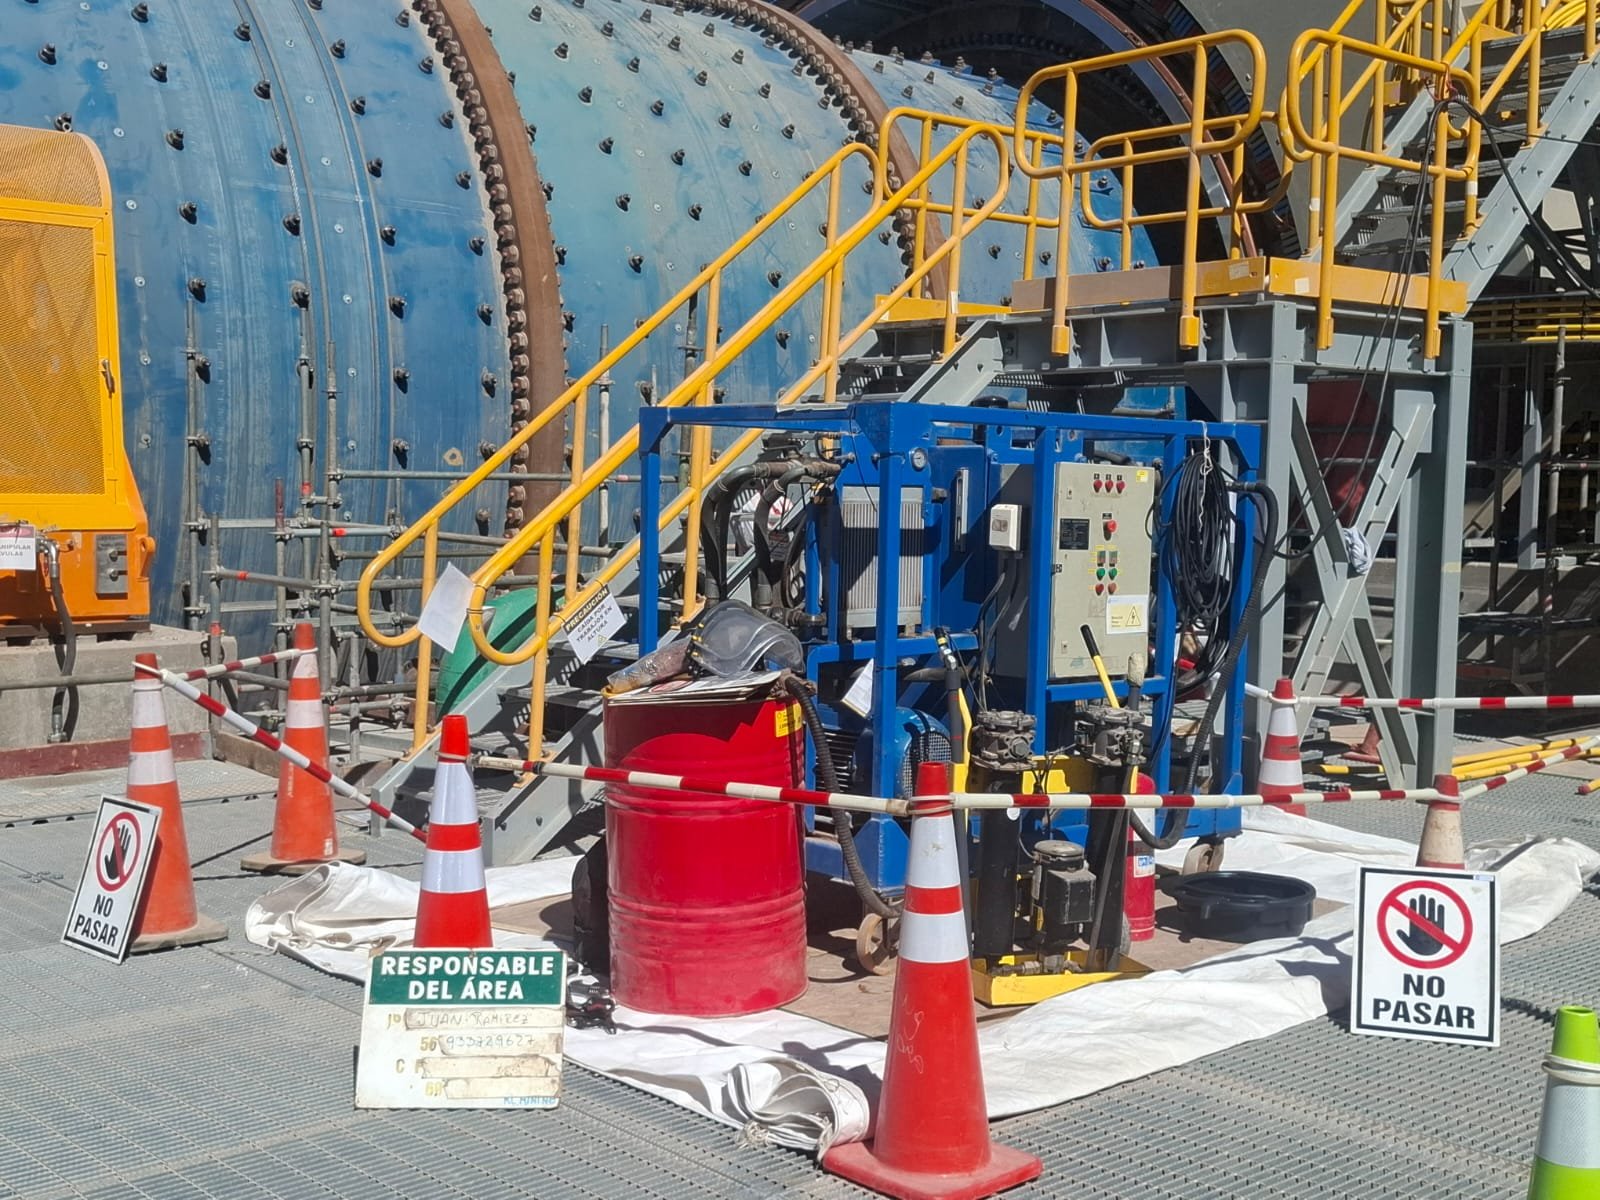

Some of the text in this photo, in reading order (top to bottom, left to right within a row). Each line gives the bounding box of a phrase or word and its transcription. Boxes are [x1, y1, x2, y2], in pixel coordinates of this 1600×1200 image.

[594, 603, 606, 616] POR
[576, 605, 613, 643] TRABAJOS EN
[587, 619, 608, 643] ALTURA
[93, 894, 114, 917] NO
[73, 914, 119, 947] PASAR
[381, 956, 554, 976] RESPONSABLE
[408, 976, 524, 999] DEL ÁREA
[1402, 973, 1446, 998] NO
[1372, 998, 1475, 1030] PASAR
